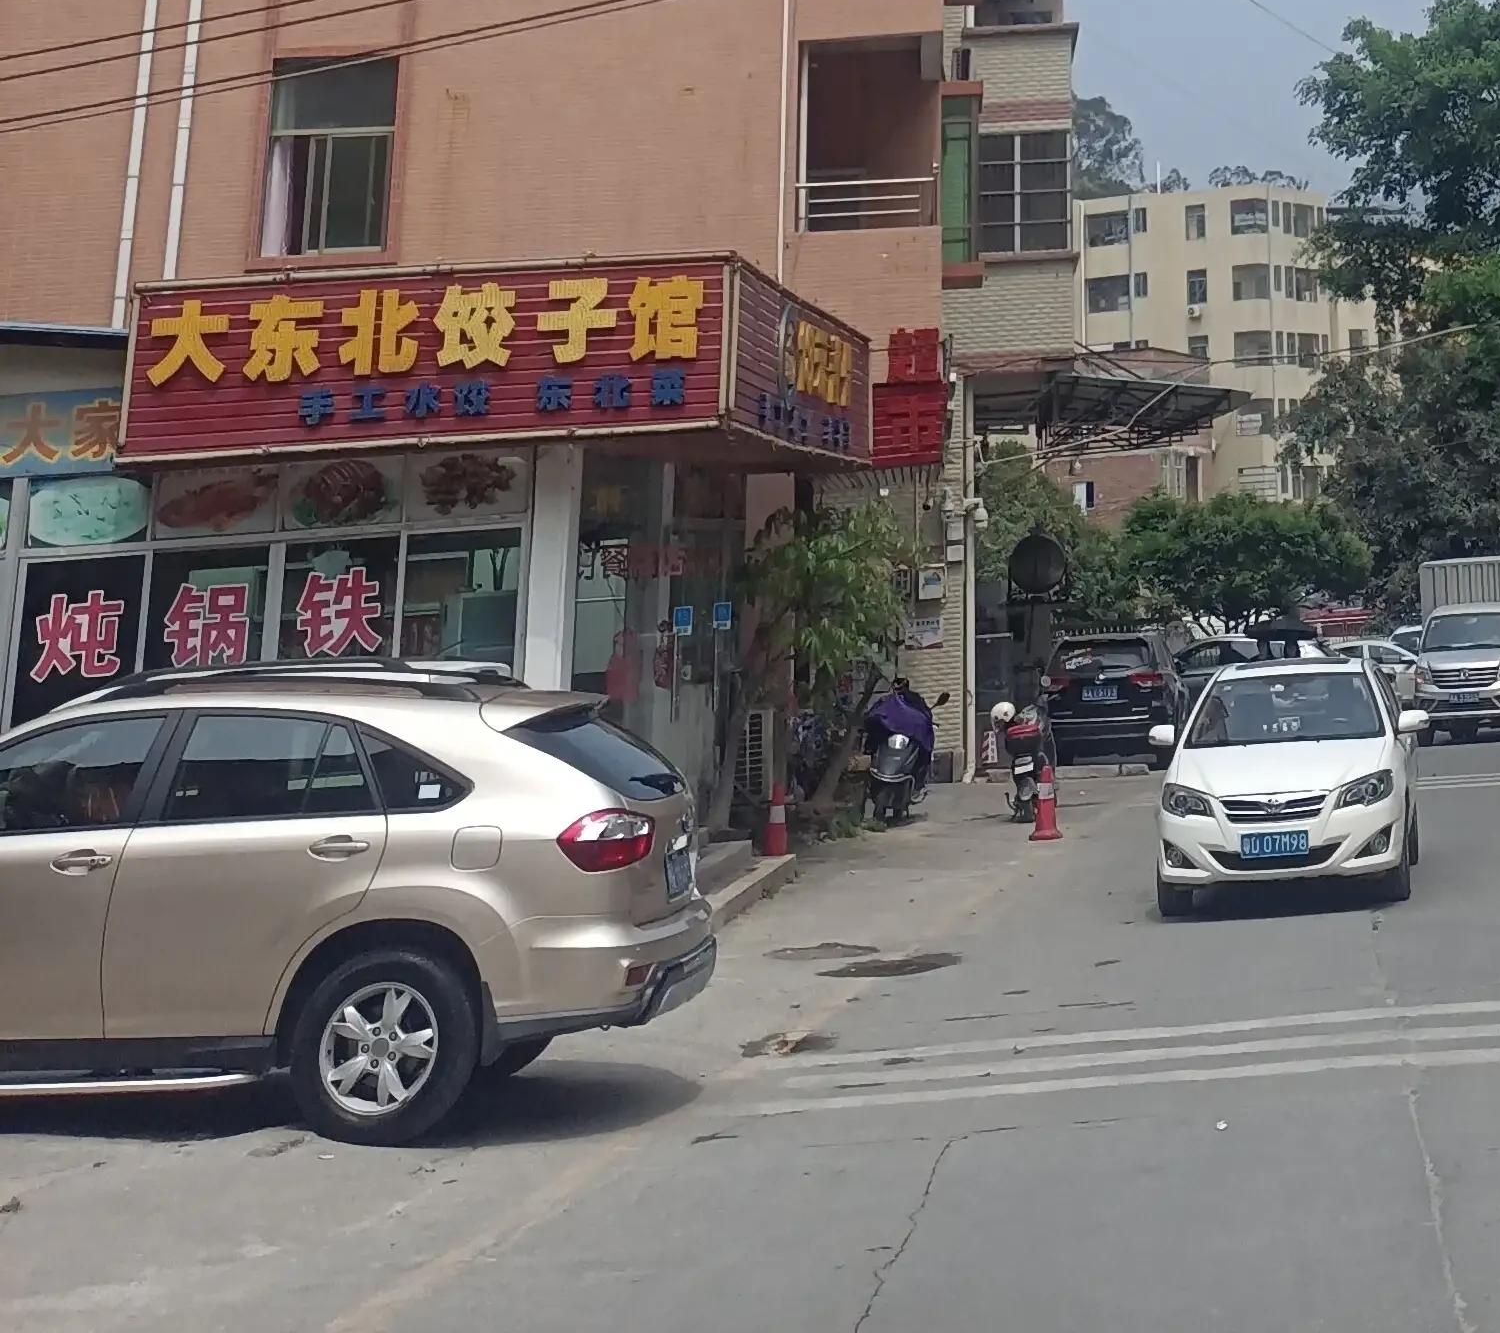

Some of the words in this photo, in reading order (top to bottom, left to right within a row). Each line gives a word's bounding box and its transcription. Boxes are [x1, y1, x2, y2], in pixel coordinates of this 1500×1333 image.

[146, 275, 704, 387] 大东北饺子馆
[299, 381, 491, 426] 手工水饺
[536, 368, 686, 412] 东北菜
